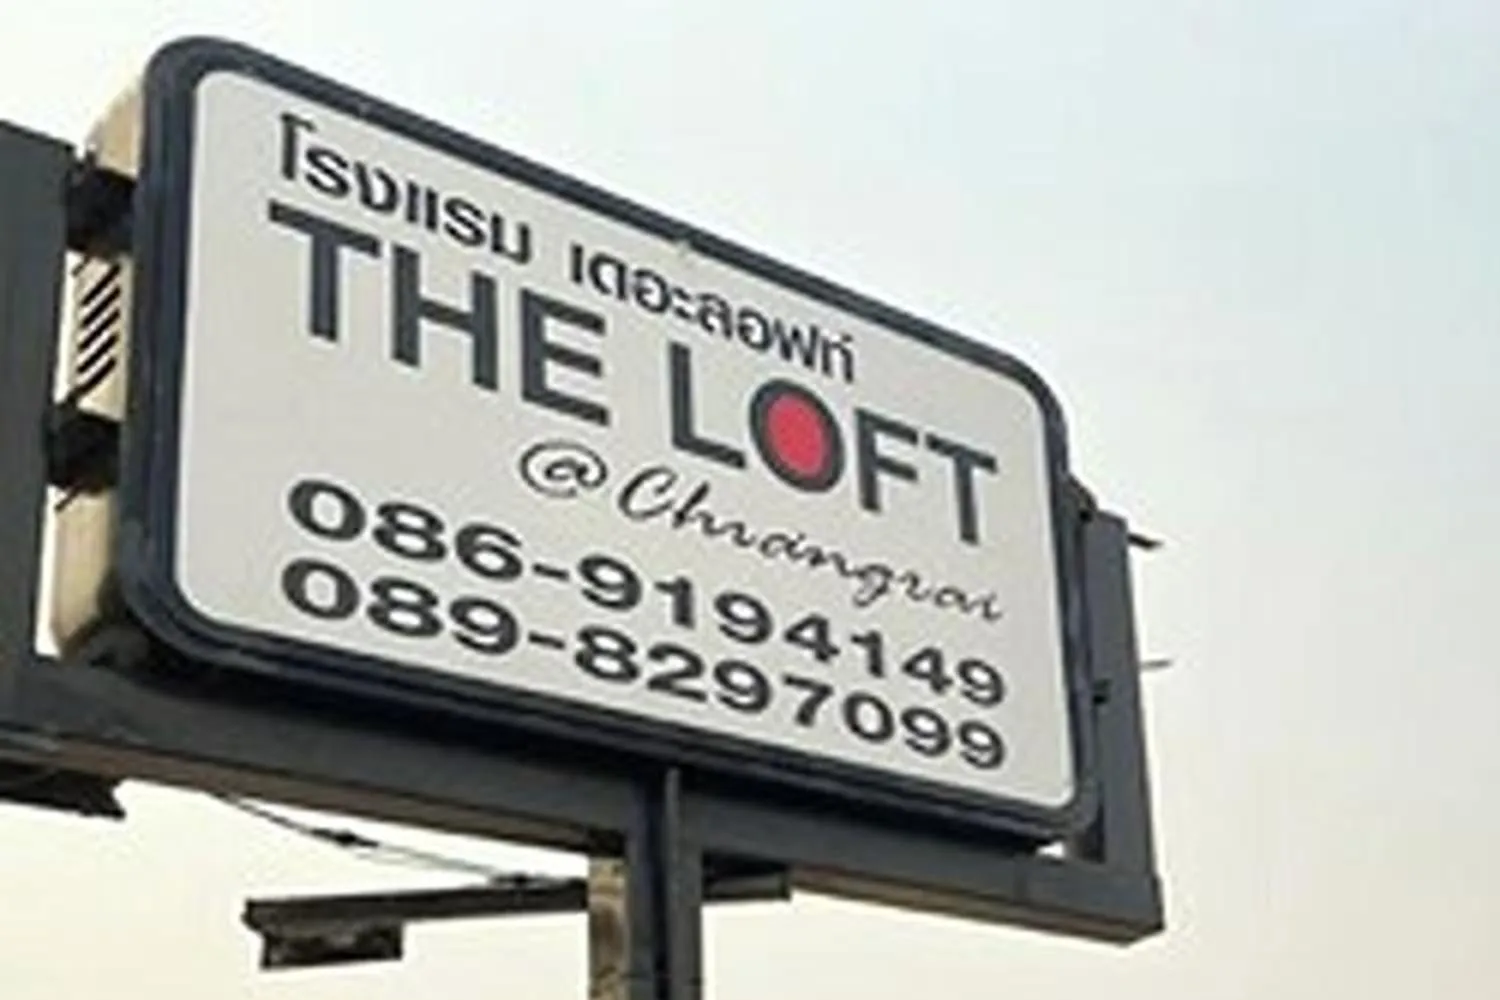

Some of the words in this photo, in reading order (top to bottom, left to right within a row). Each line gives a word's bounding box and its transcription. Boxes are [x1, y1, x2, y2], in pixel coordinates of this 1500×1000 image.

[280, 112, 531, 264] โรงแรม
[268, 200, 609, 426] THE
[669, 342, 998, 545] LOFT
[282, 557, 1006, 770] 089-8297099
[287, 478, 1006, 708] 086-9194149
